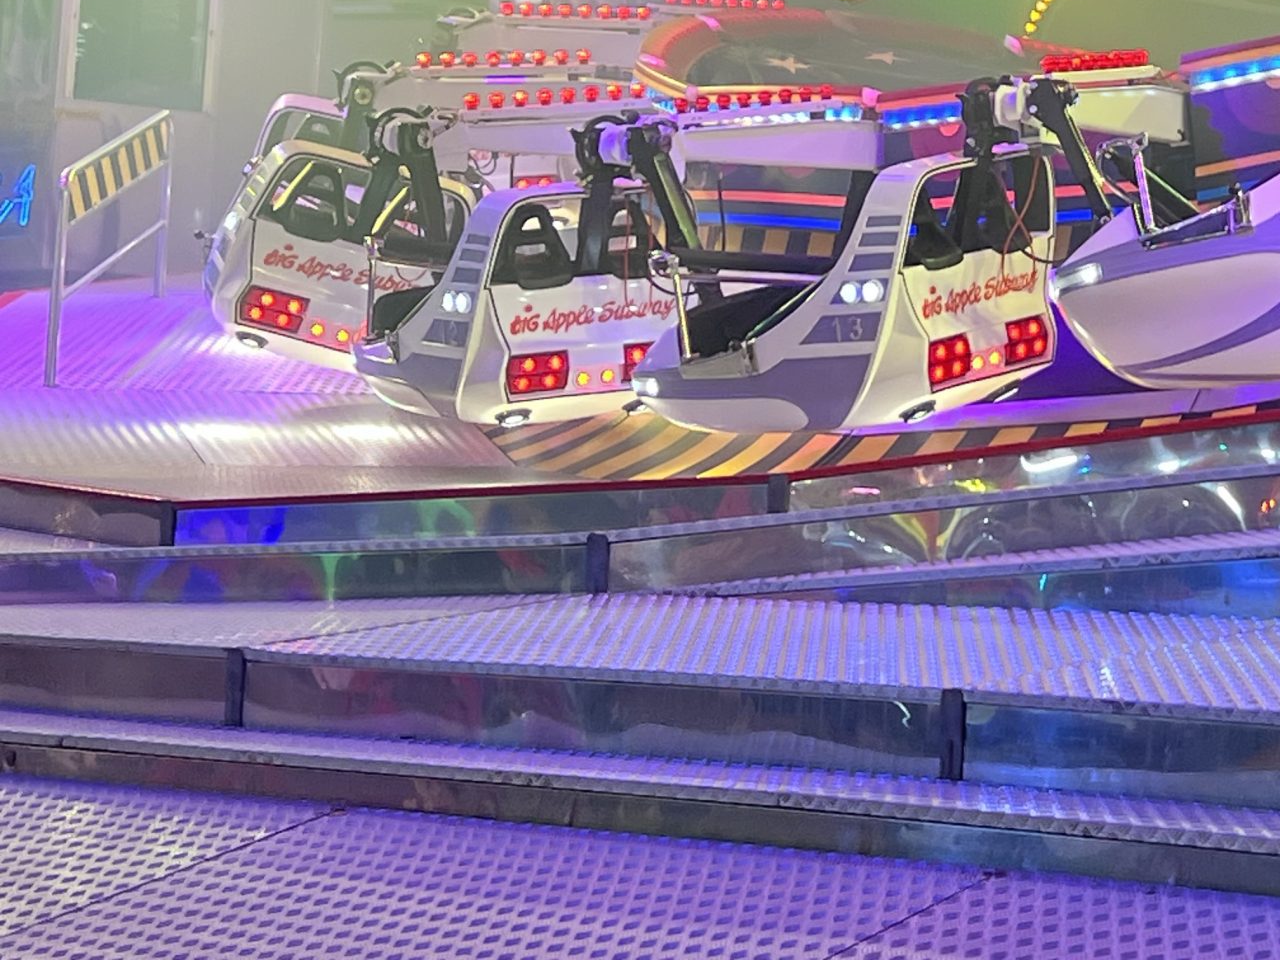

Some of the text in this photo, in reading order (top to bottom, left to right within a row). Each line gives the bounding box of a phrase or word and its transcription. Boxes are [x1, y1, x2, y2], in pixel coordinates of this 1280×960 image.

[542, 304, 597, 334] Apple
[597, 297, 676, 323] Subway
[832, 317, 863, 343] 13
